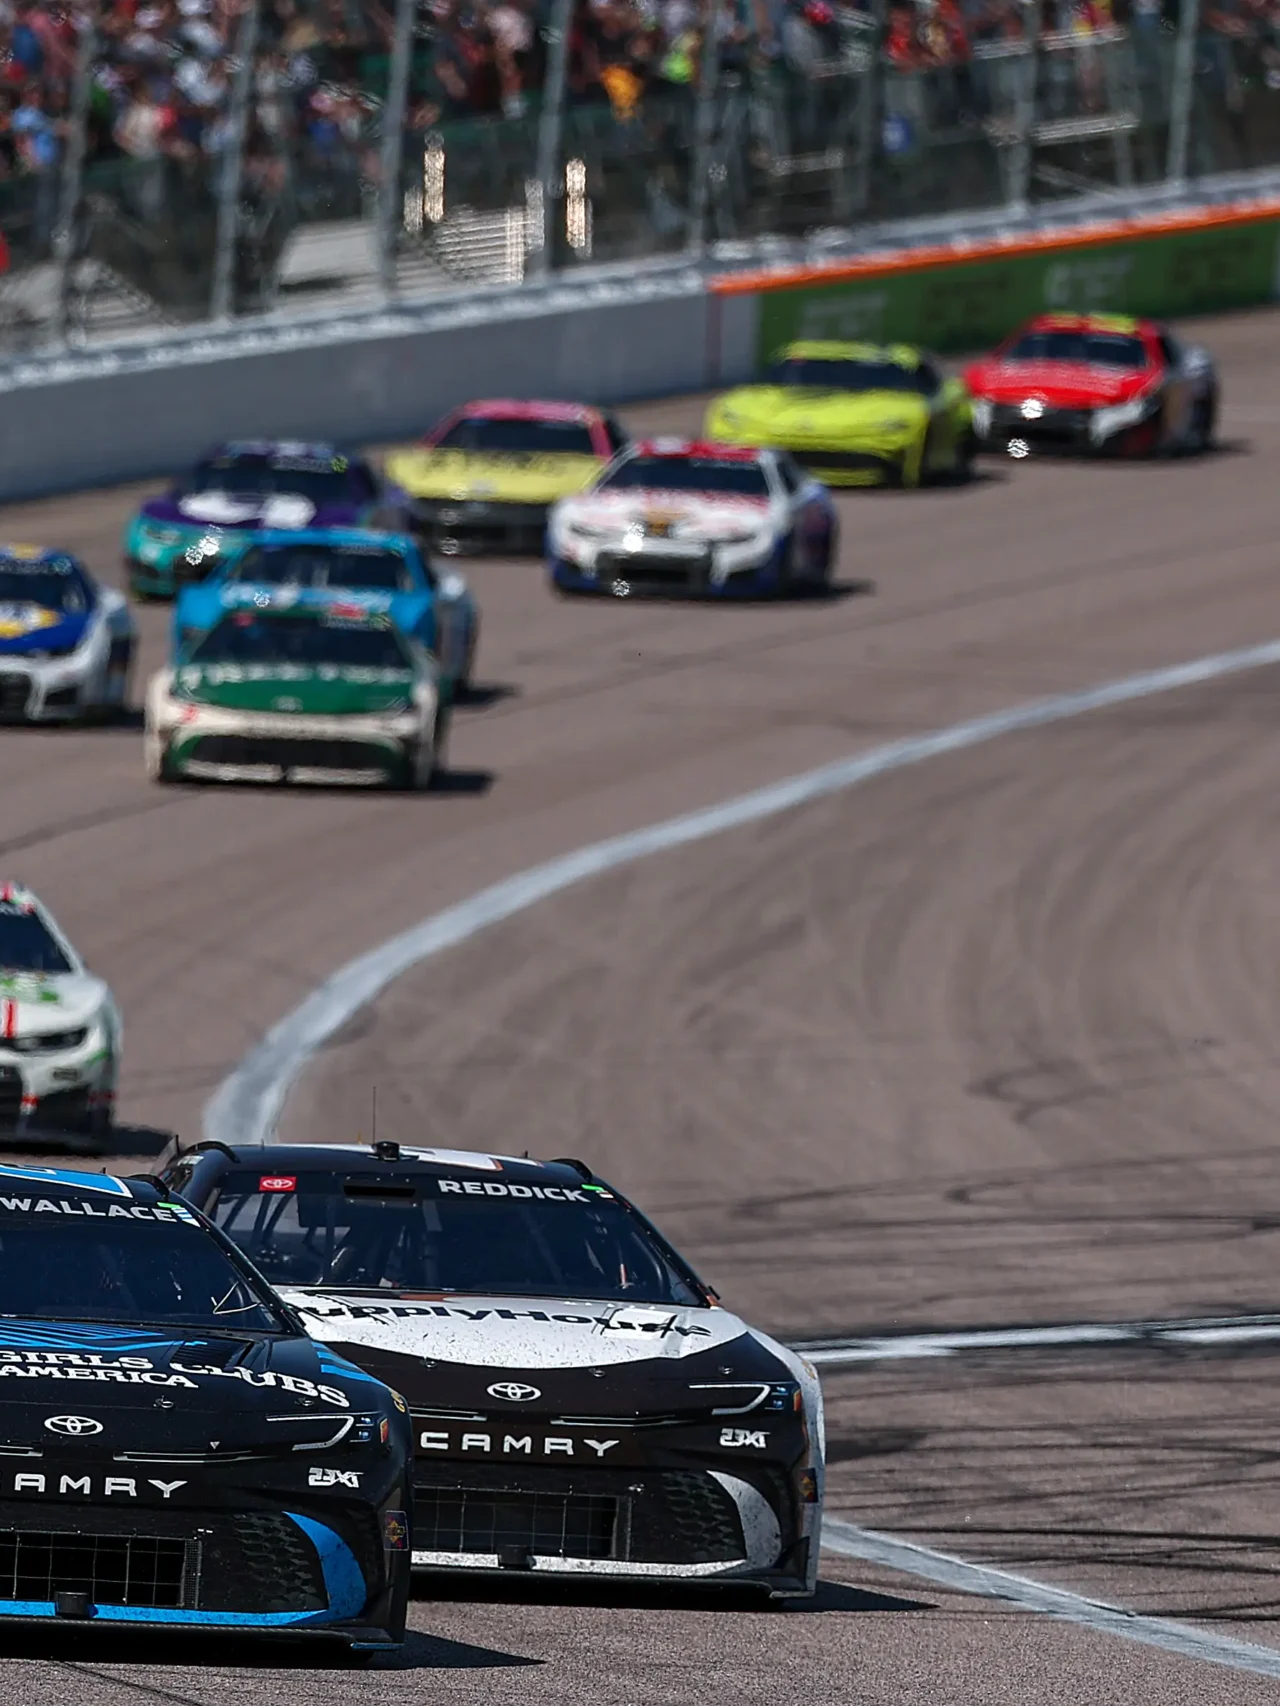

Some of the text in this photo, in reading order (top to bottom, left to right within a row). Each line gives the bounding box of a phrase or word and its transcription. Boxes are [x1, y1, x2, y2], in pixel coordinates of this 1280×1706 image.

[438, 1179, 590, 1202] REDDICK
[170, 1362, 350, 1408] CLUBS
[420, 1432, 620, 1457] CAMRY
